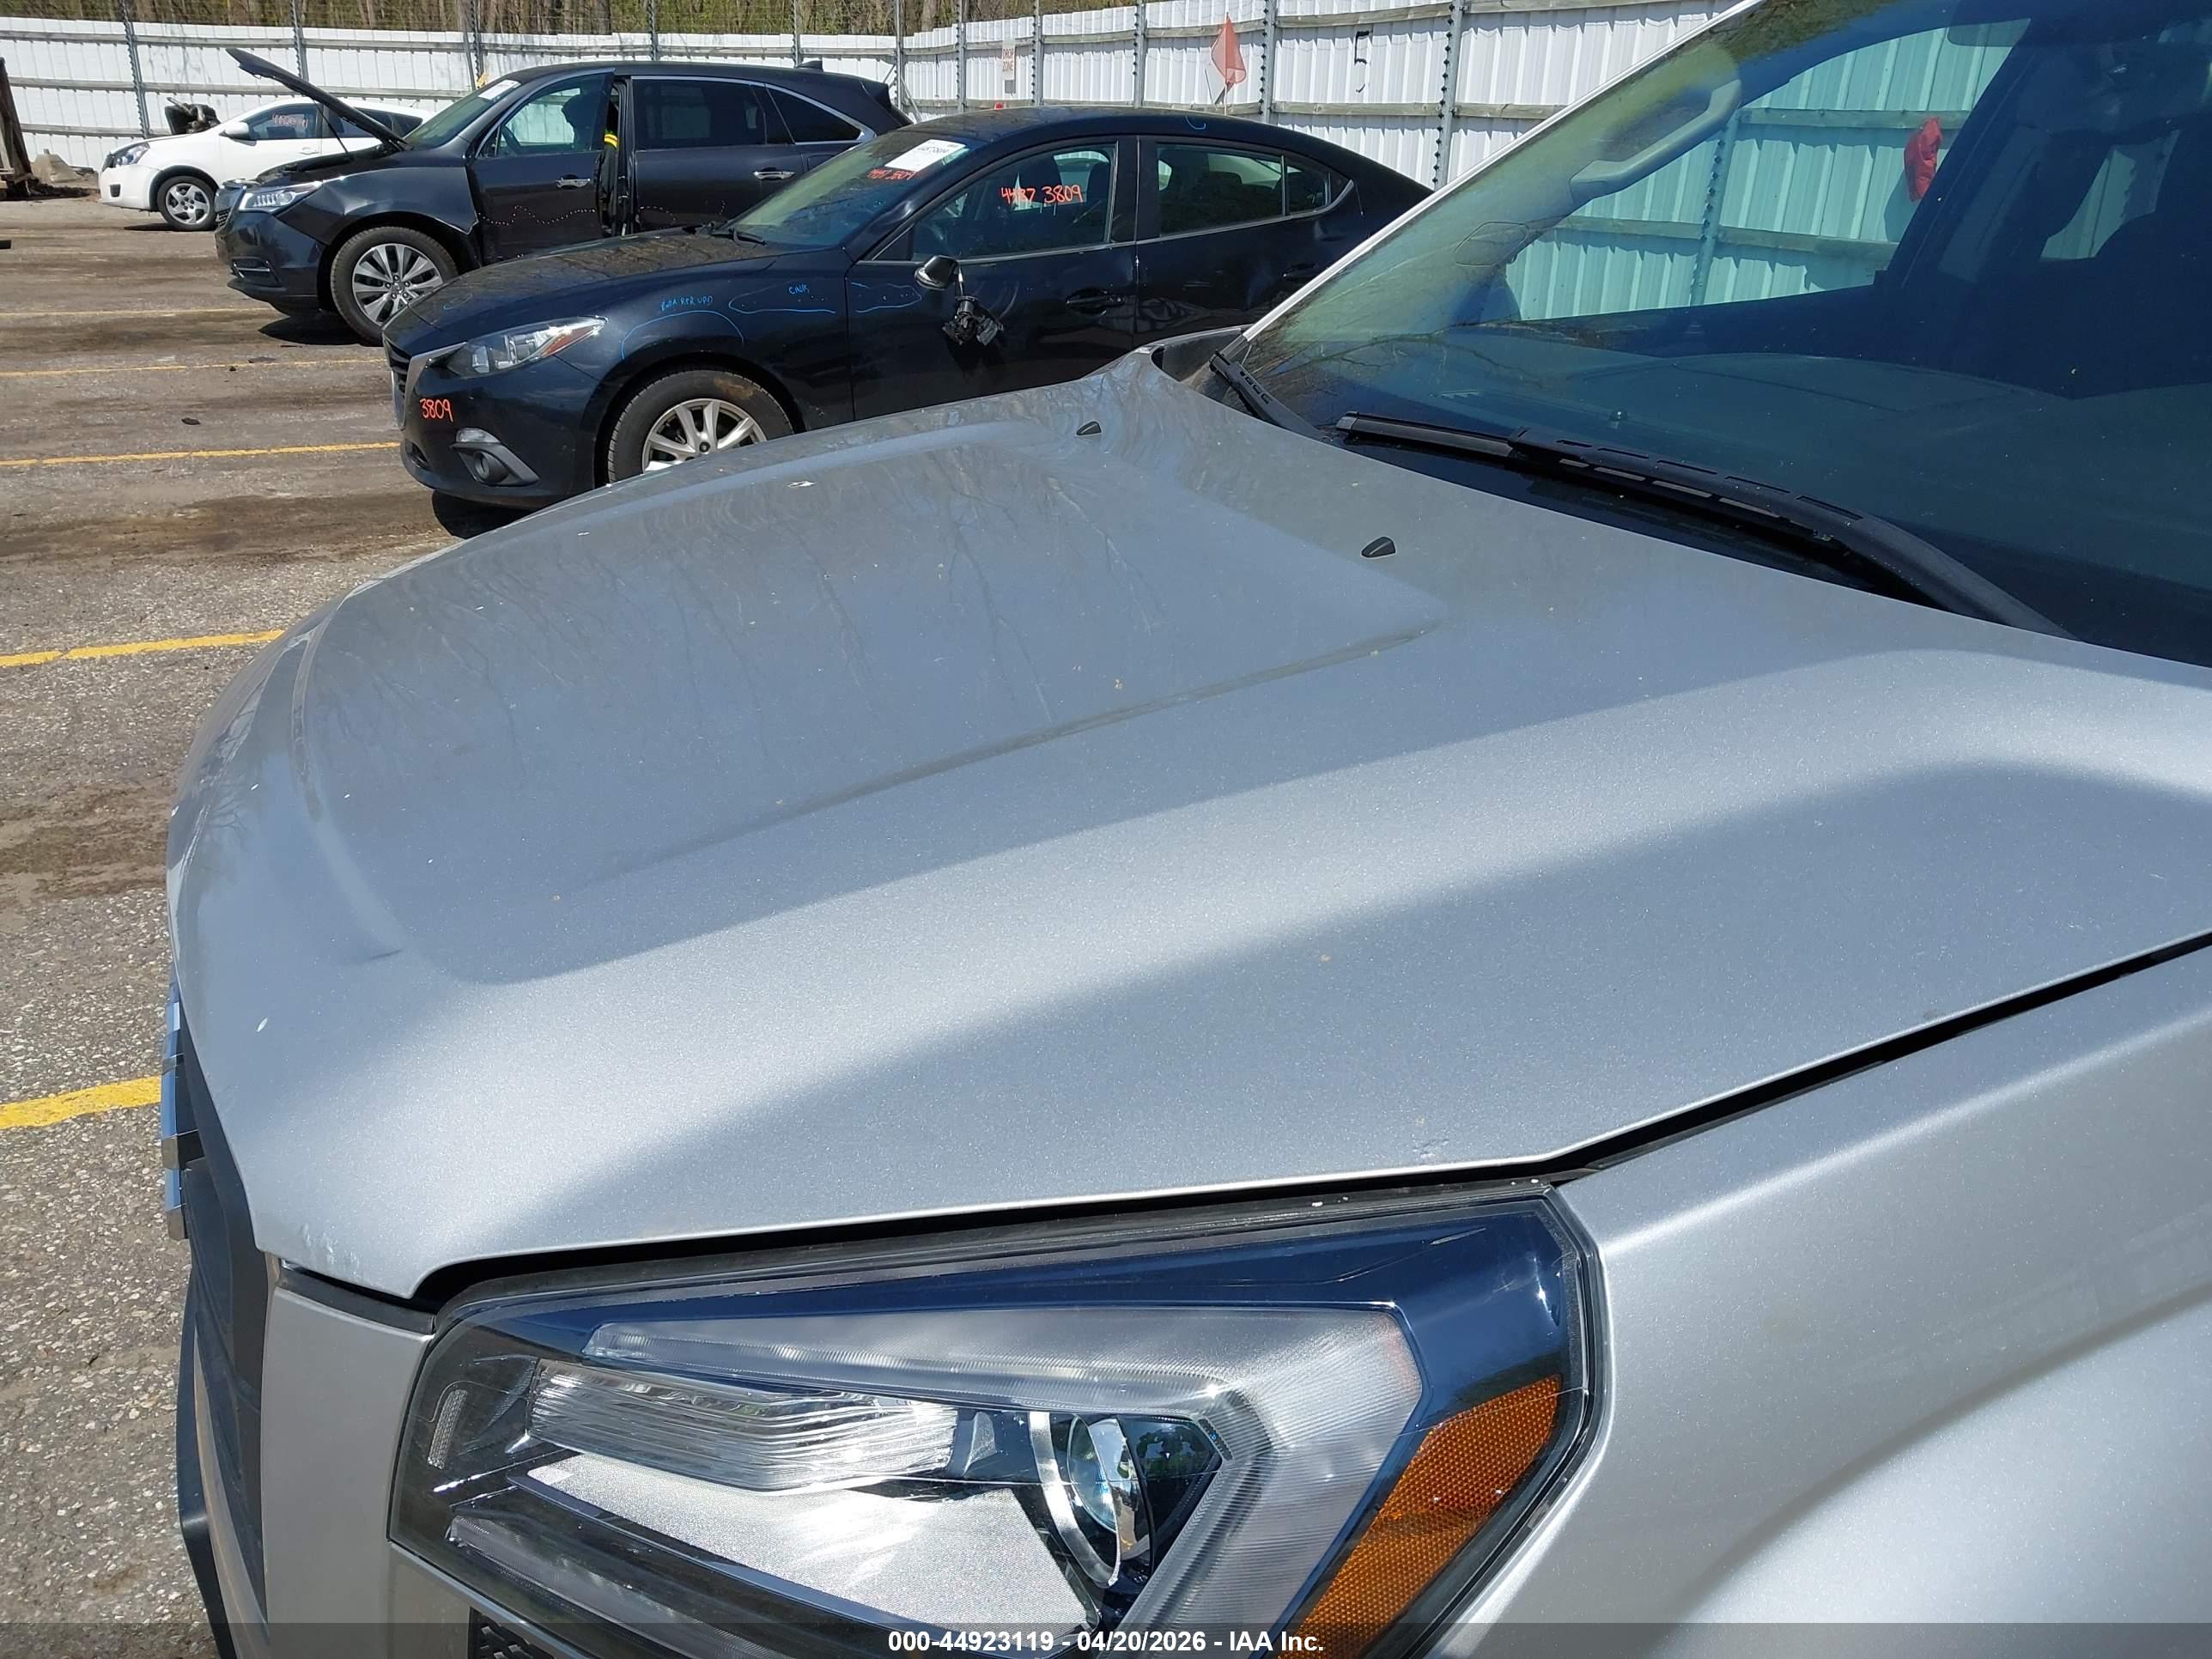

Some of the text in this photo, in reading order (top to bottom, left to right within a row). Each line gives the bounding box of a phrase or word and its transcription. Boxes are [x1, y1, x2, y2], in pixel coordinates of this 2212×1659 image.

[1003, 48, 1014, 59] DROP
[1003, 61, 1014, 71] ZONE
[1042, 185, 1084, 204] 3809
[419, 398, 454, 422] 3809
